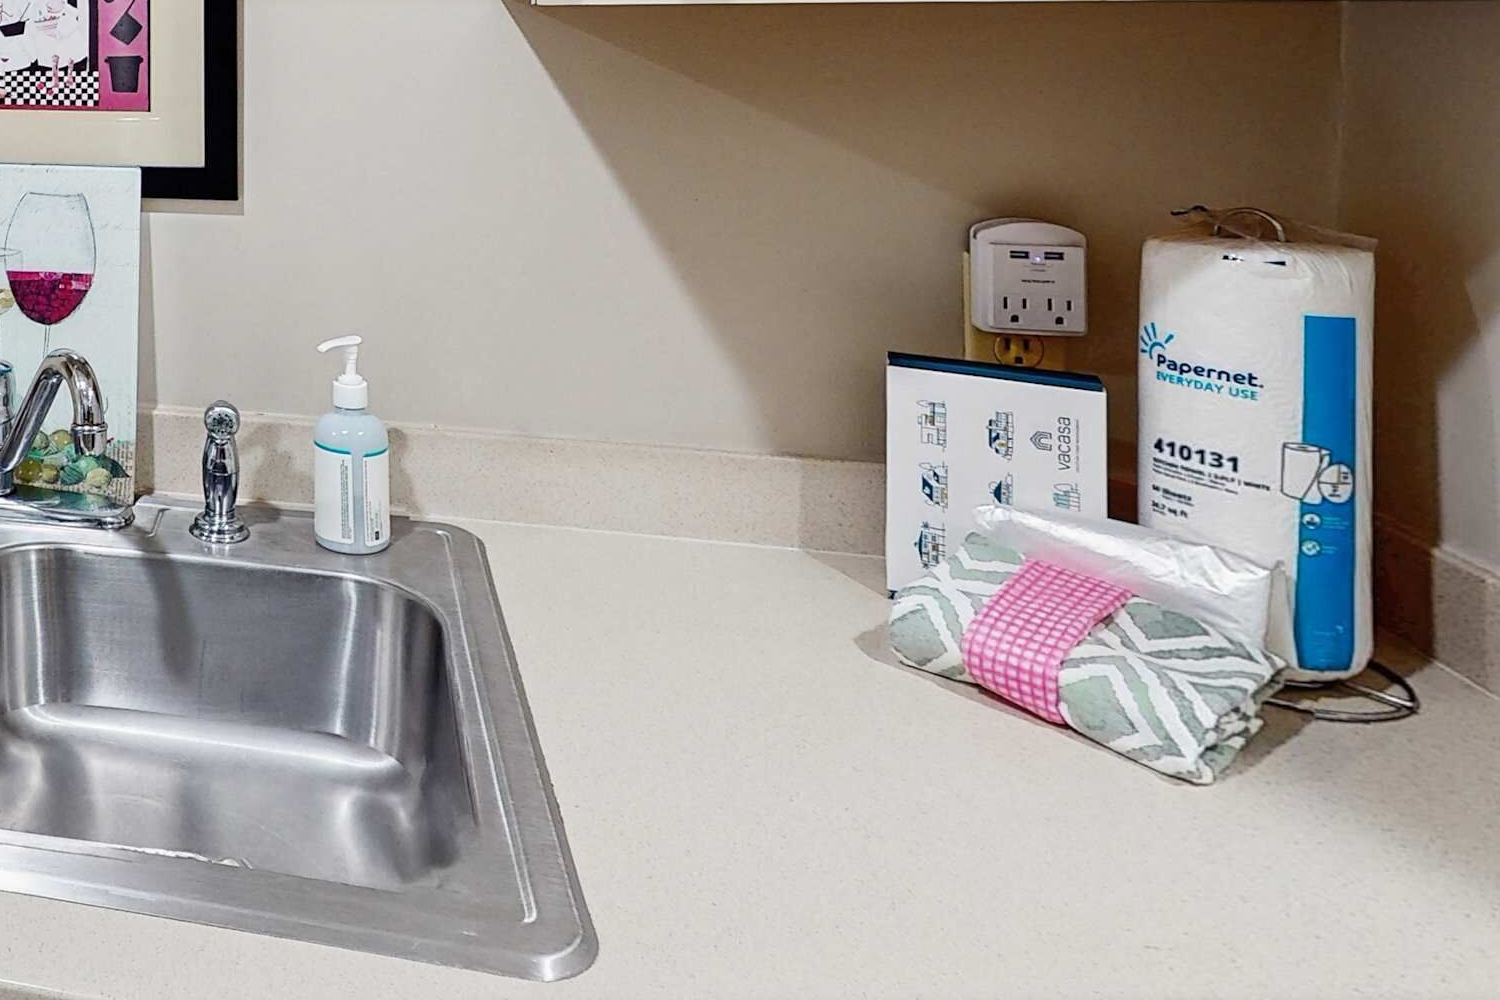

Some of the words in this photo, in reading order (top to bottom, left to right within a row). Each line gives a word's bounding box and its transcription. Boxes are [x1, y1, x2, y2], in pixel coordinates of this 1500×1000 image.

[1156, 370, 1224, 395] EVERYDAY
[1227, 386, 1259, 401] USE
[1057, 415, 1072, 471] vacasa
[1153, 437, 1239, 474] 410131
